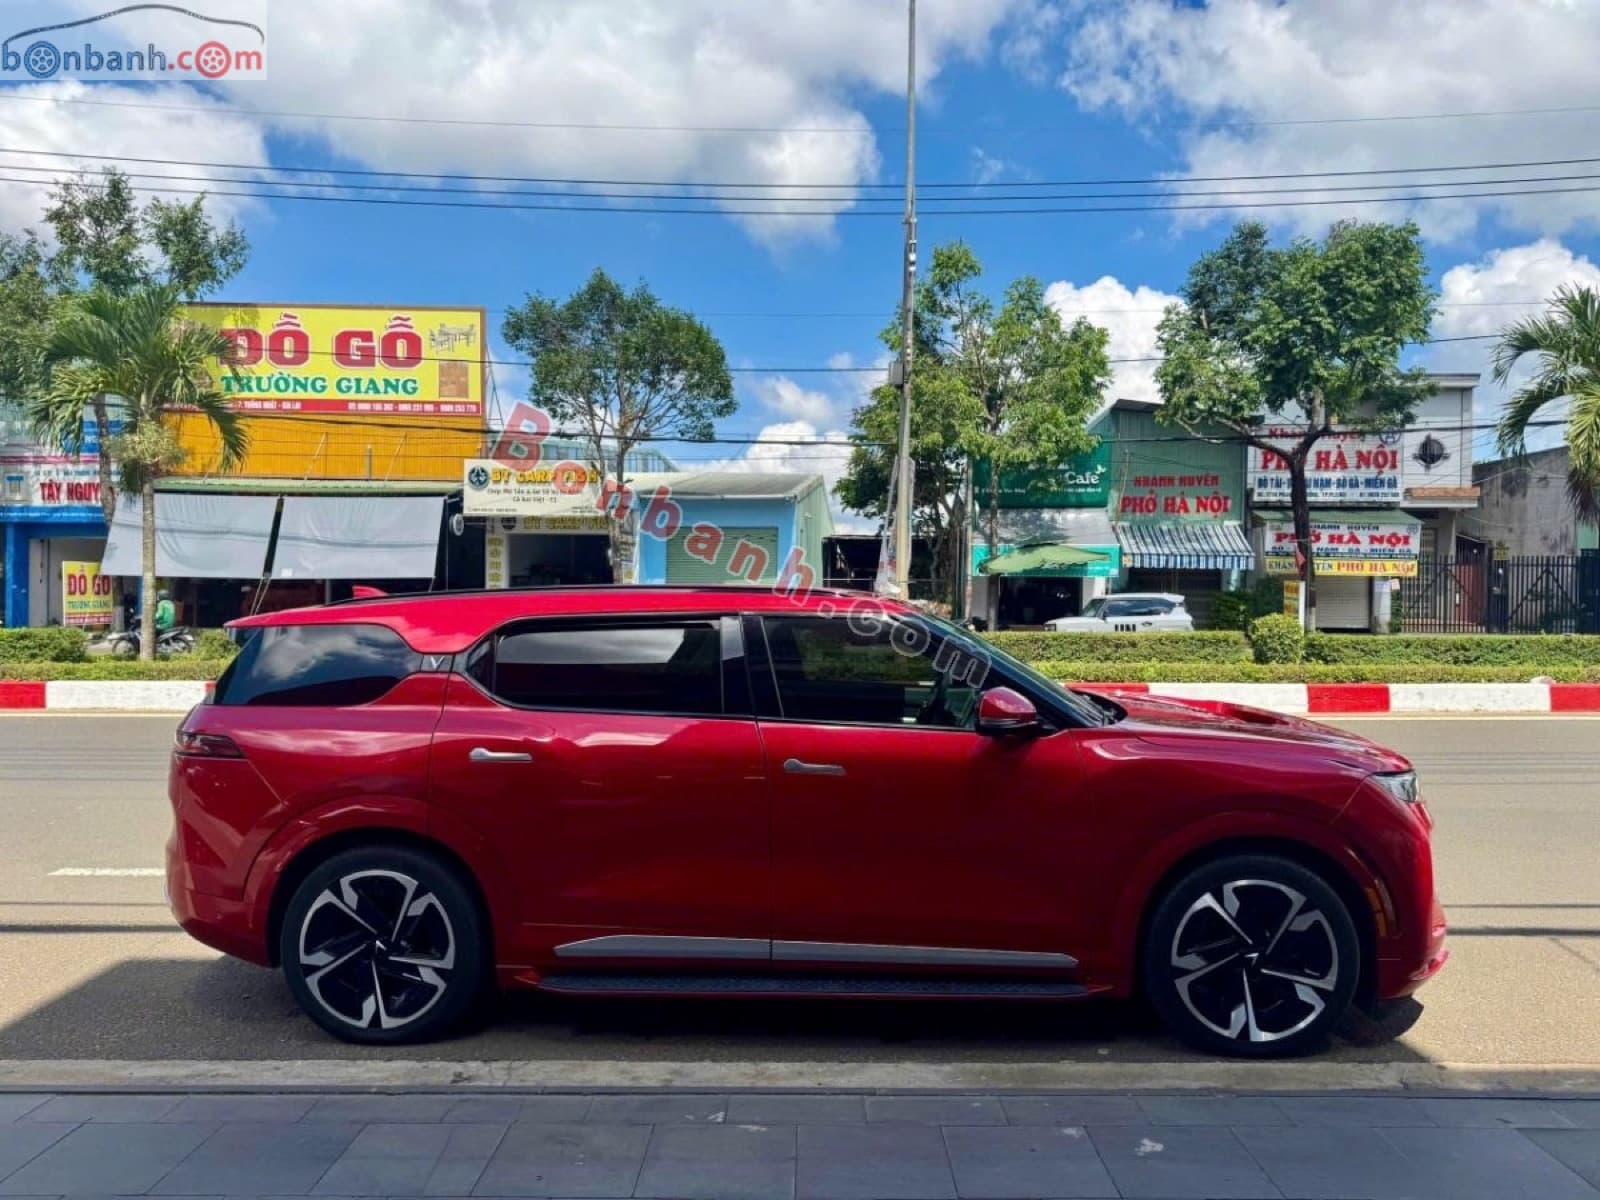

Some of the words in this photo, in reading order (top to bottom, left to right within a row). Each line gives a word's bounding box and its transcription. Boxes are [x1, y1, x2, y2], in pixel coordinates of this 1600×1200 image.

[333, 315, 422, 368] GỖ
[220, 371, 327, 394] TRƯỜNG
[336, 378, 418, 395] GIANG
[1262, 446, 1307, 470] PH
[1315, 444, 1349, 470] HÀ
[1355, 444, 1397, 475] NỘI
[40, 479, 61, 502] TÂY
[67, 482, 101, 502] NGUY
[1164, 491, 1190, 513] HÀ
[1196, 491, 1230, 518] NỘI
[1328, 531, 1360, 545] HÀ
[1369, 532, 1410, 547] NỘI
